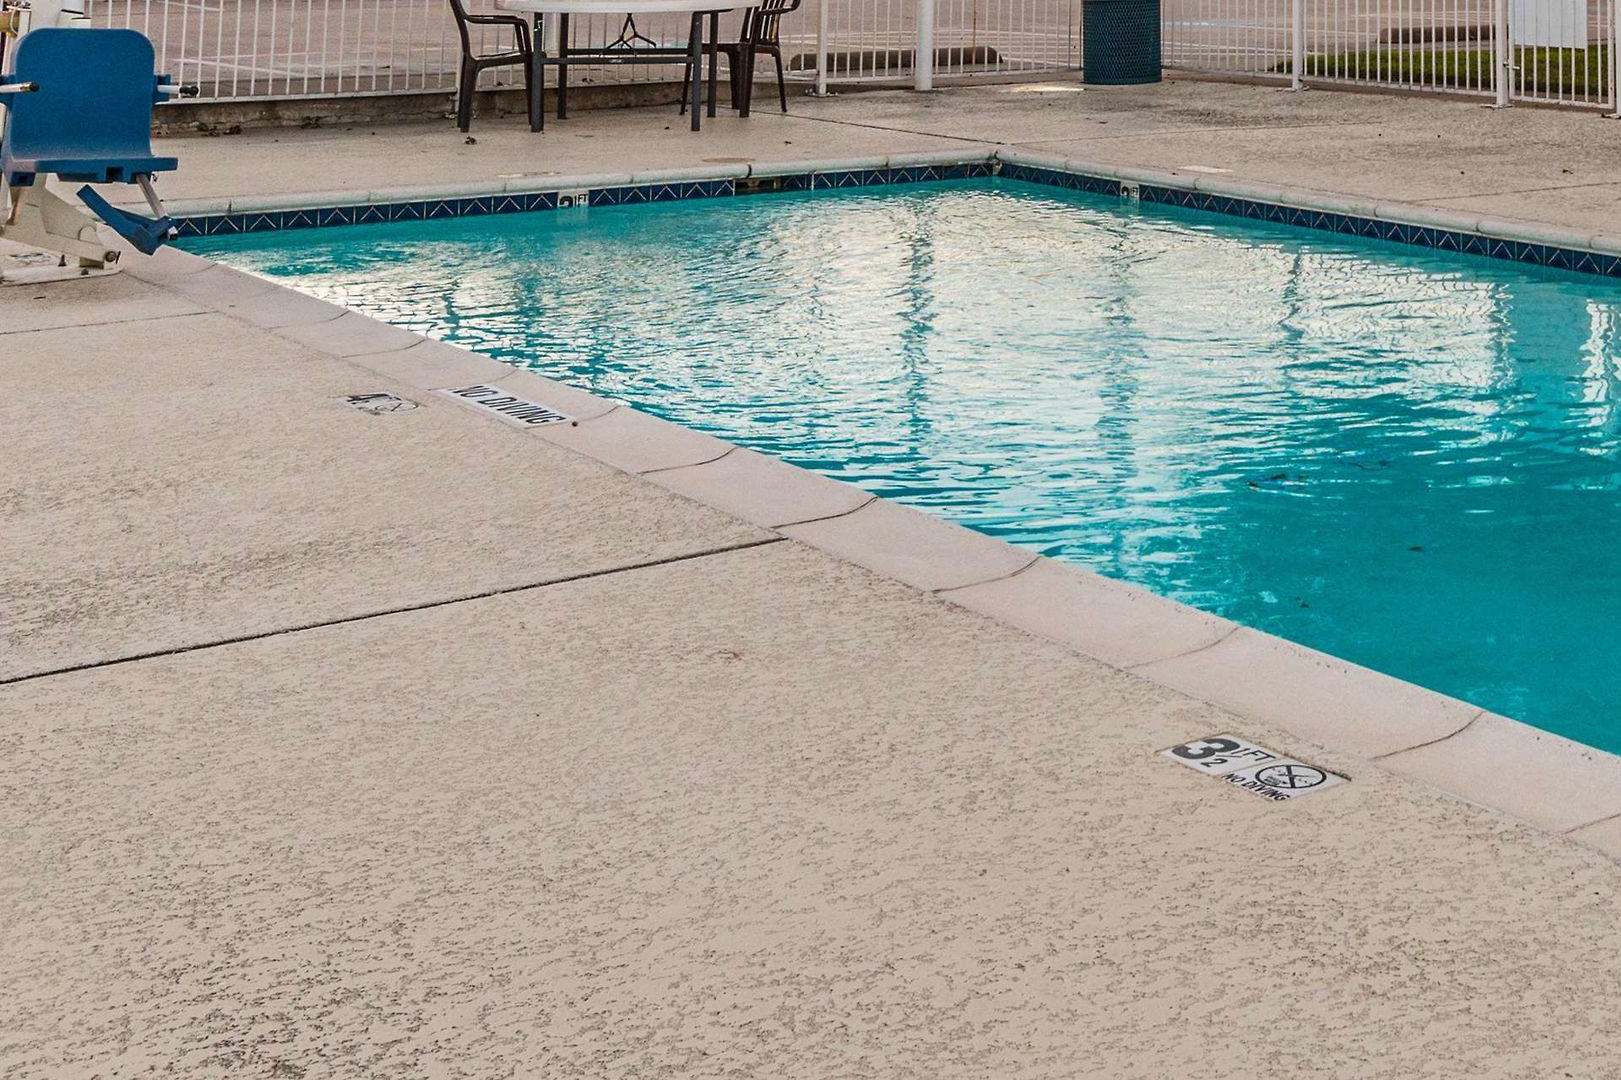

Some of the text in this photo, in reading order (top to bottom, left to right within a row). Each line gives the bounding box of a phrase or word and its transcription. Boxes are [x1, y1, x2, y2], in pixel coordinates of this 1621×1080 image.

[453, 385, 566, 424] NO DIVING
[1241, 780, 1290, 801] DIVING
